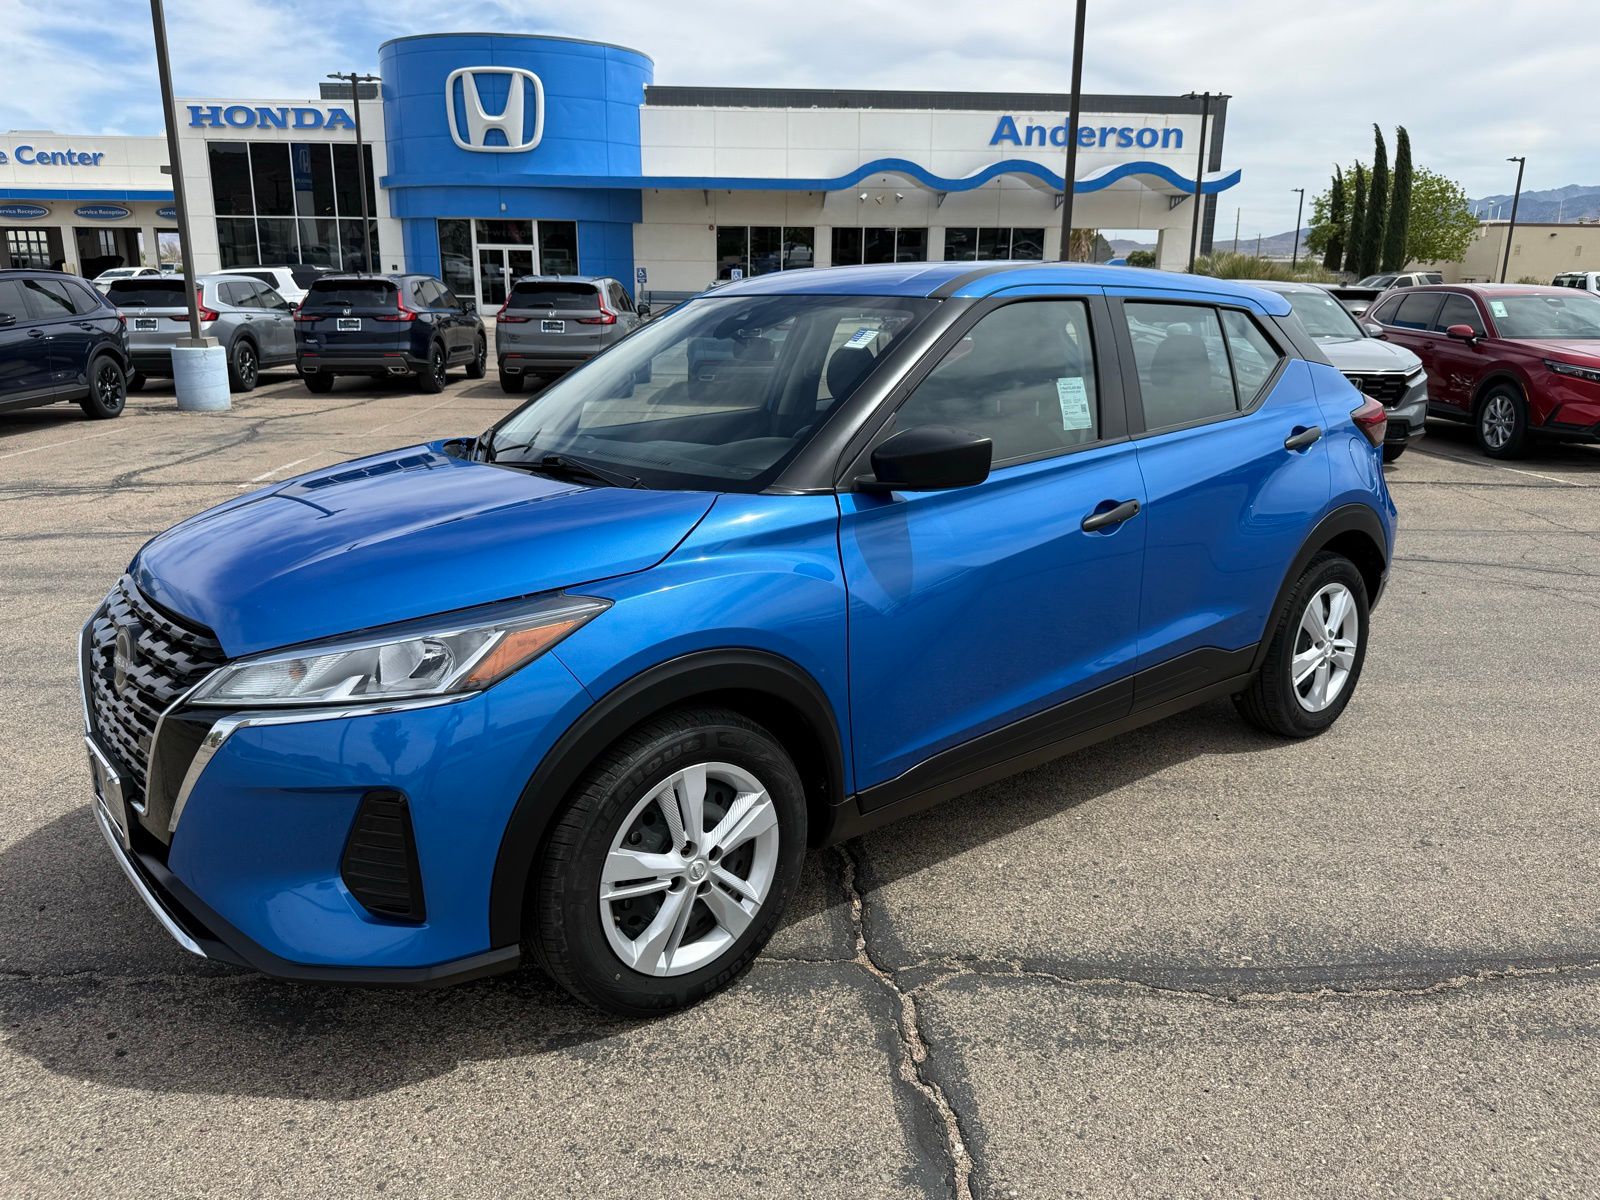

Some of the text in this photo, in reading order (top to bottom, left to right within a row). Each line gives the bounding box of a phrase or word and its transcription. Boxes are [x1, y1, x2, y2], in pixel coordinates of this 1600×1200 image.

[187, 105, 356, 130] HONDA
[989, 115, 1184, 149] Anderson
[14, 145, 104, 166] Center
